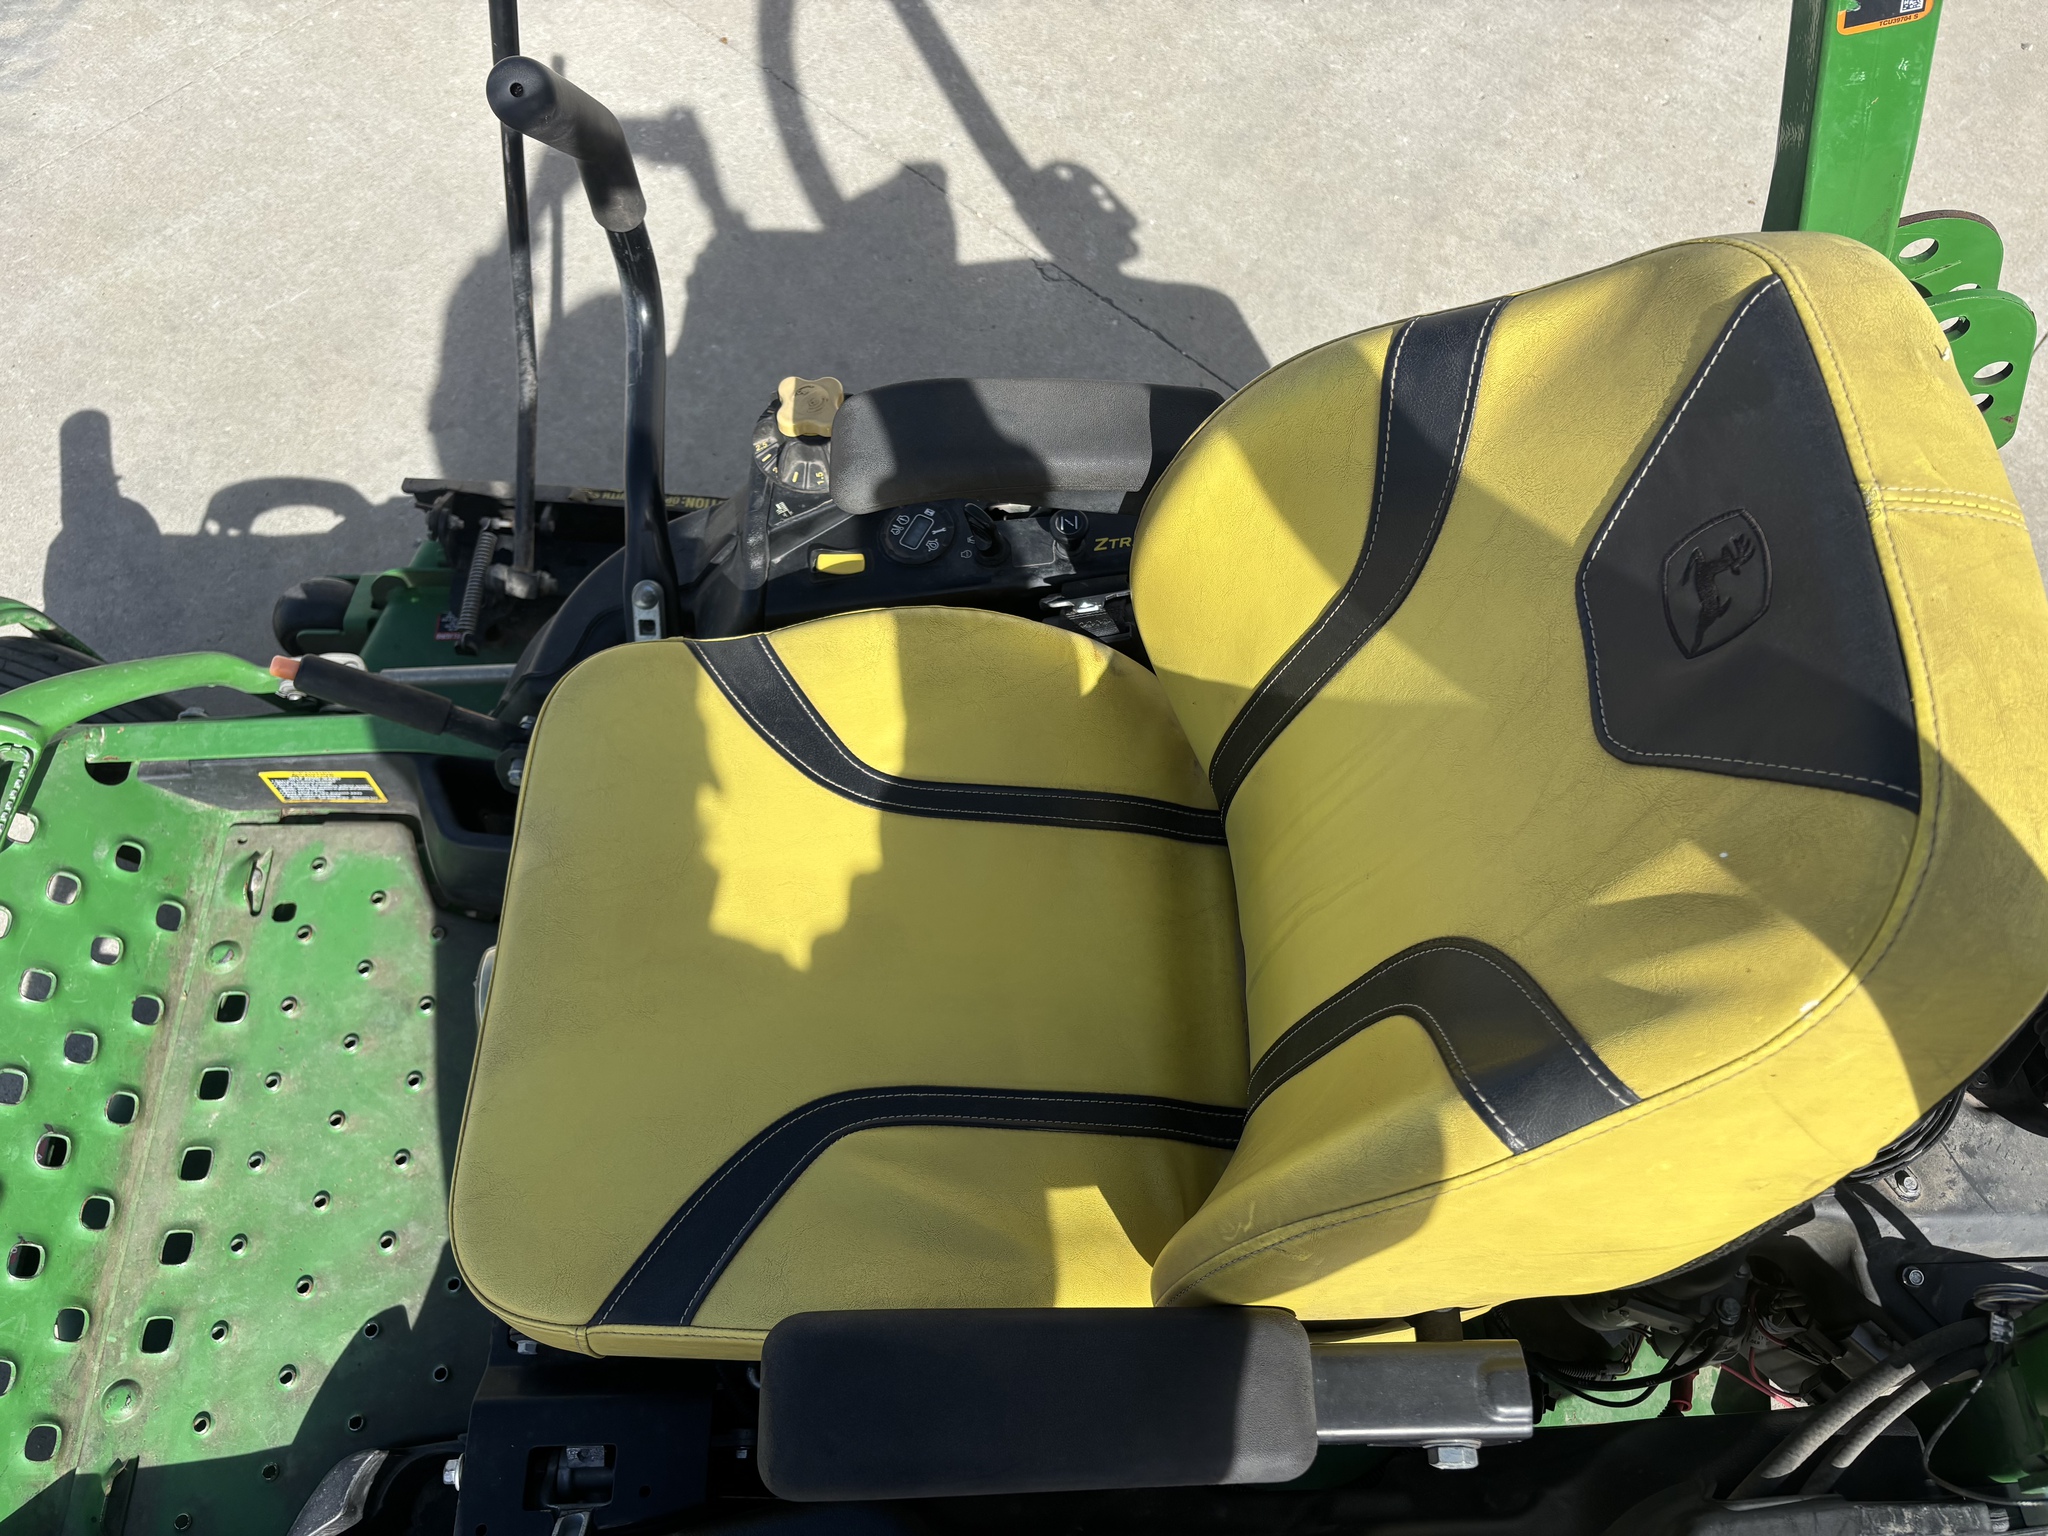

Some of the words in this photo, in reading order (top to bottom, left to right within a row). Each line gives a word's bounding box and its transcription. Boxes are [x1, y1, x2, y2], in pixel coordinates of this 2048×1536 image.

[755, 441, 768, 452] 2.5
[815, 471, 825, 485] 1.5
[1093, 537, 1134, 552] ZTR
